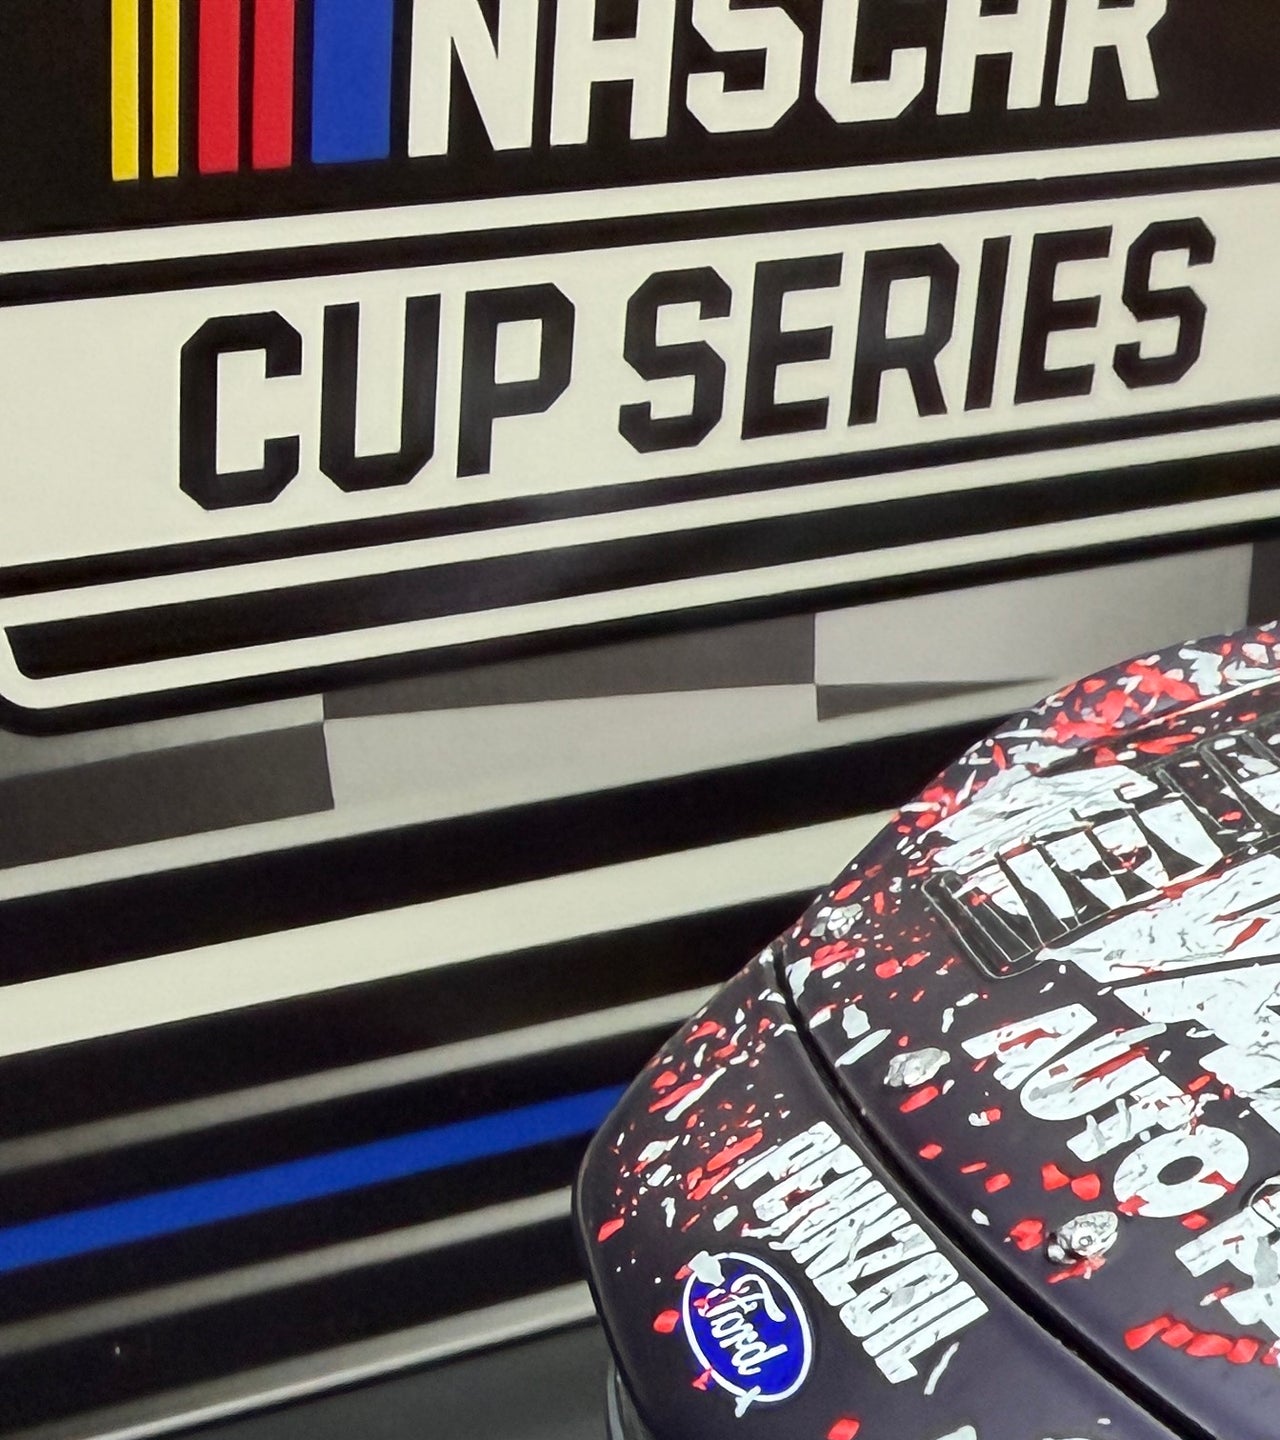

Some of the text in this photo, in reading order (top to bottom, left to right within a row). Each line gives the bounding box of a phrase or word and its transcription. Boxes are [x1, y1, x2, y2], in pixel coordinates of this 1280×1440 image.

[178, 216, 1218, 512] CUP SERIES
[961, 1002, 1251, 1218] AUTO
[702, 1273, 789, 1376] Ford
[734, 1121, 990, 1384] PENNZOIL
